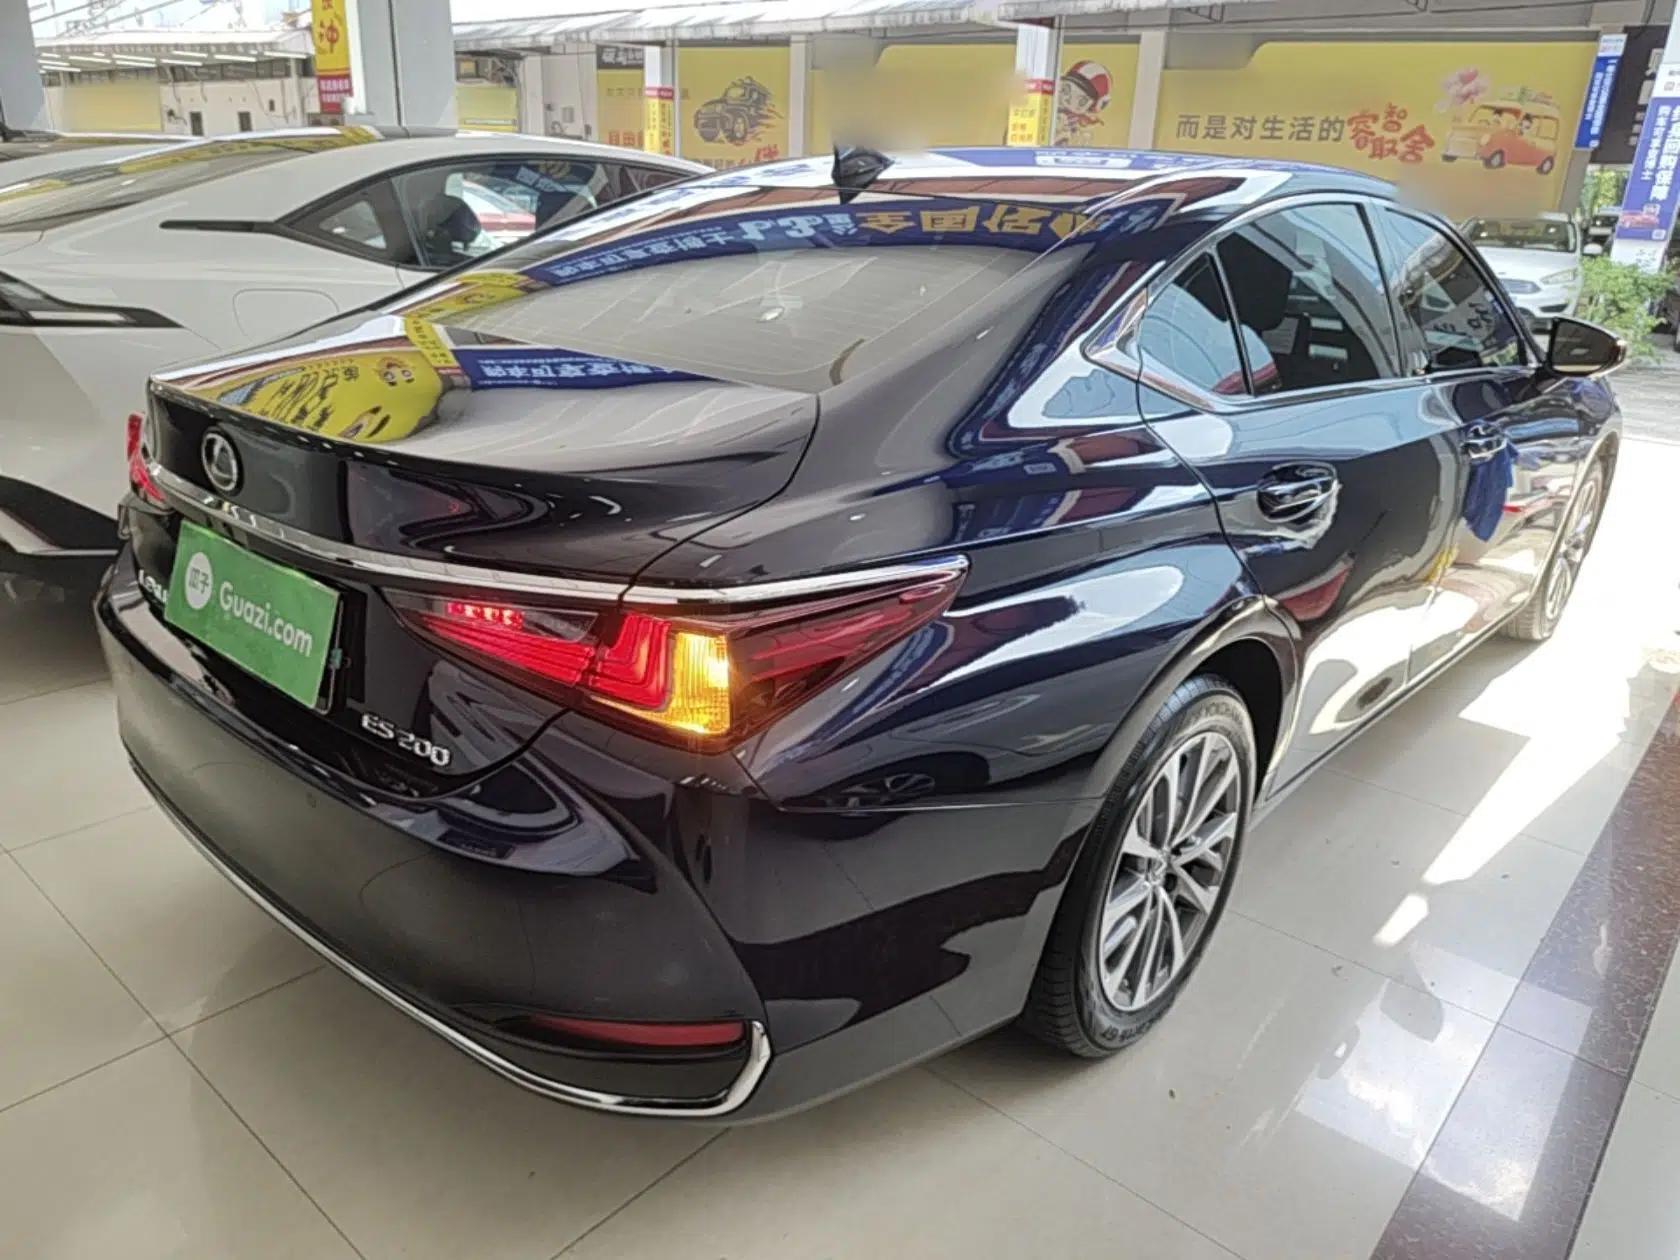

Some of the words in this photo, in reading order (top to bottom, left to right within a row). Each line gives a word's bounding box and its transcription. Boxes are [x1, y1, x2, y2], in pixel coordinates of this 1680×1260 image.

[1176, 114, 1345, 142] 而是对生活的
[362, 714, 395, 739] ES
[397, 729, 450, 766] 200
